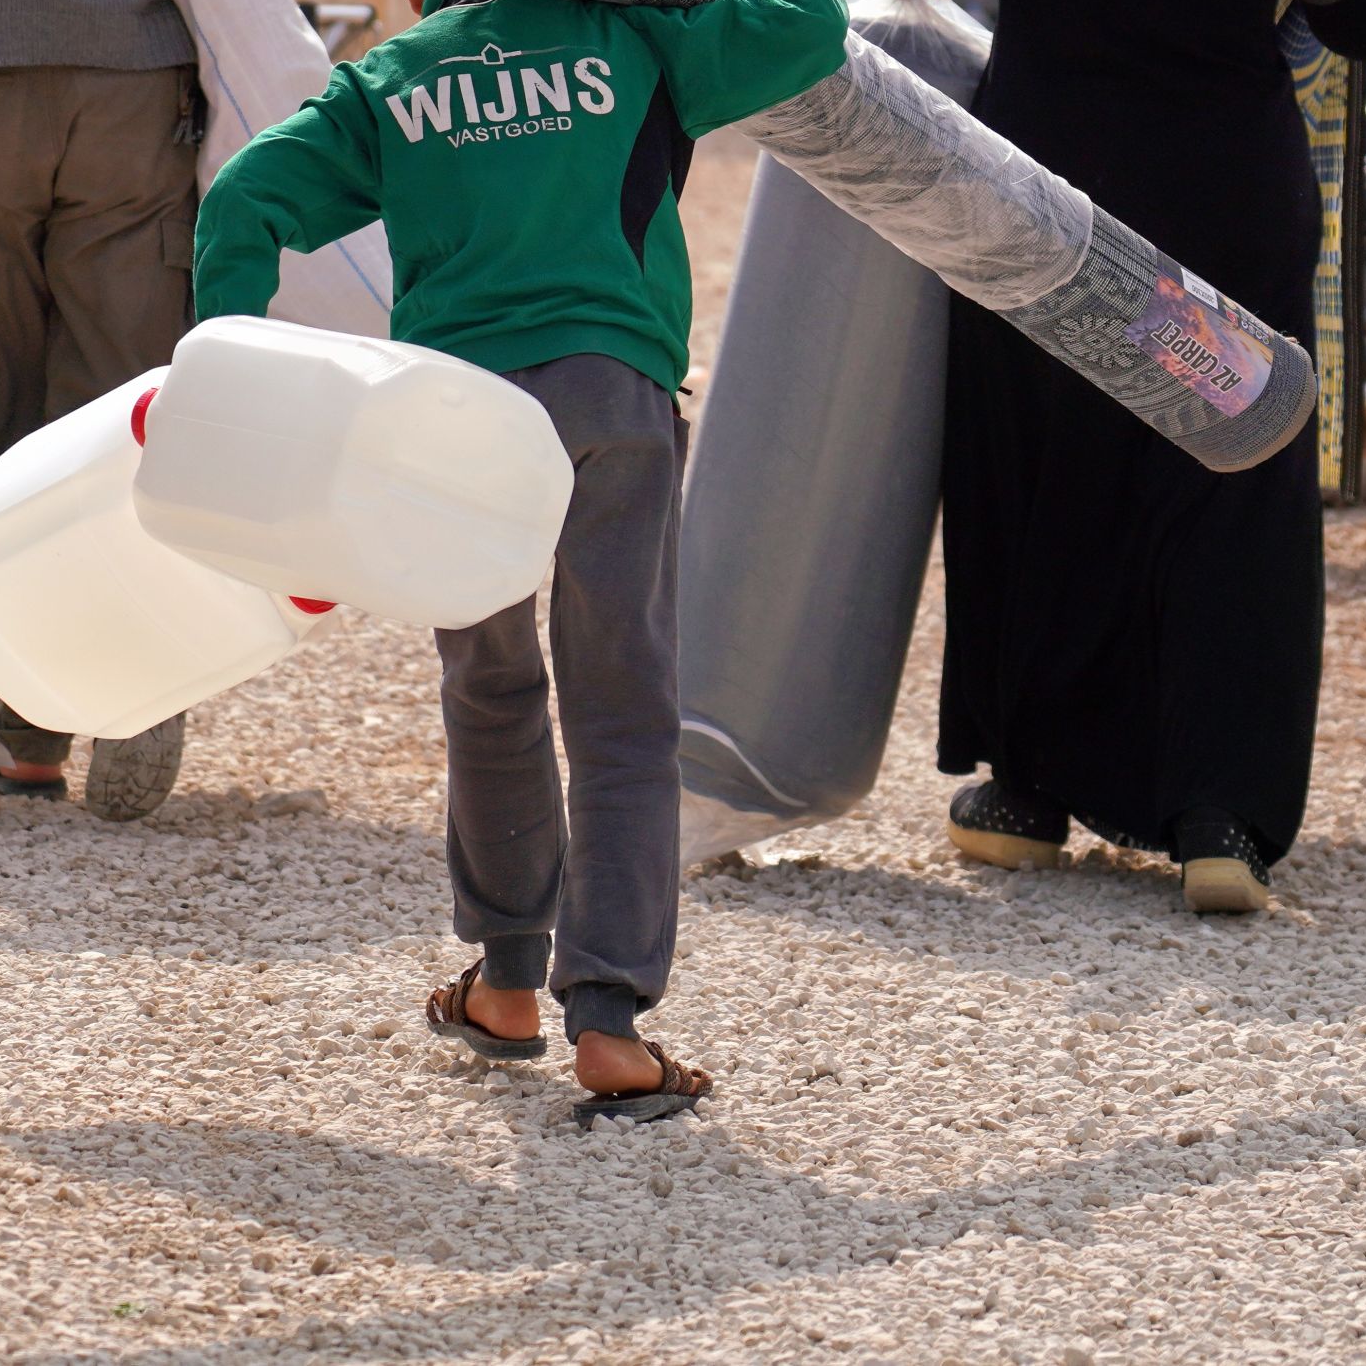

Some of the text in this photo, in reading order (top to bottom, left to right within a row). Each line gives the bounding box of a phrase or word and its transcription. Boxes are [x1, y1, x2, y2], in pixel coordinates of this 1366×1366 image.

[385, 57, 615, 143] WIJNS
[447, 116, 572, 149] VASTGOED
[1150, 319, 1220, 376] CARPET
[1209, 362, 1244, 394] AZ
